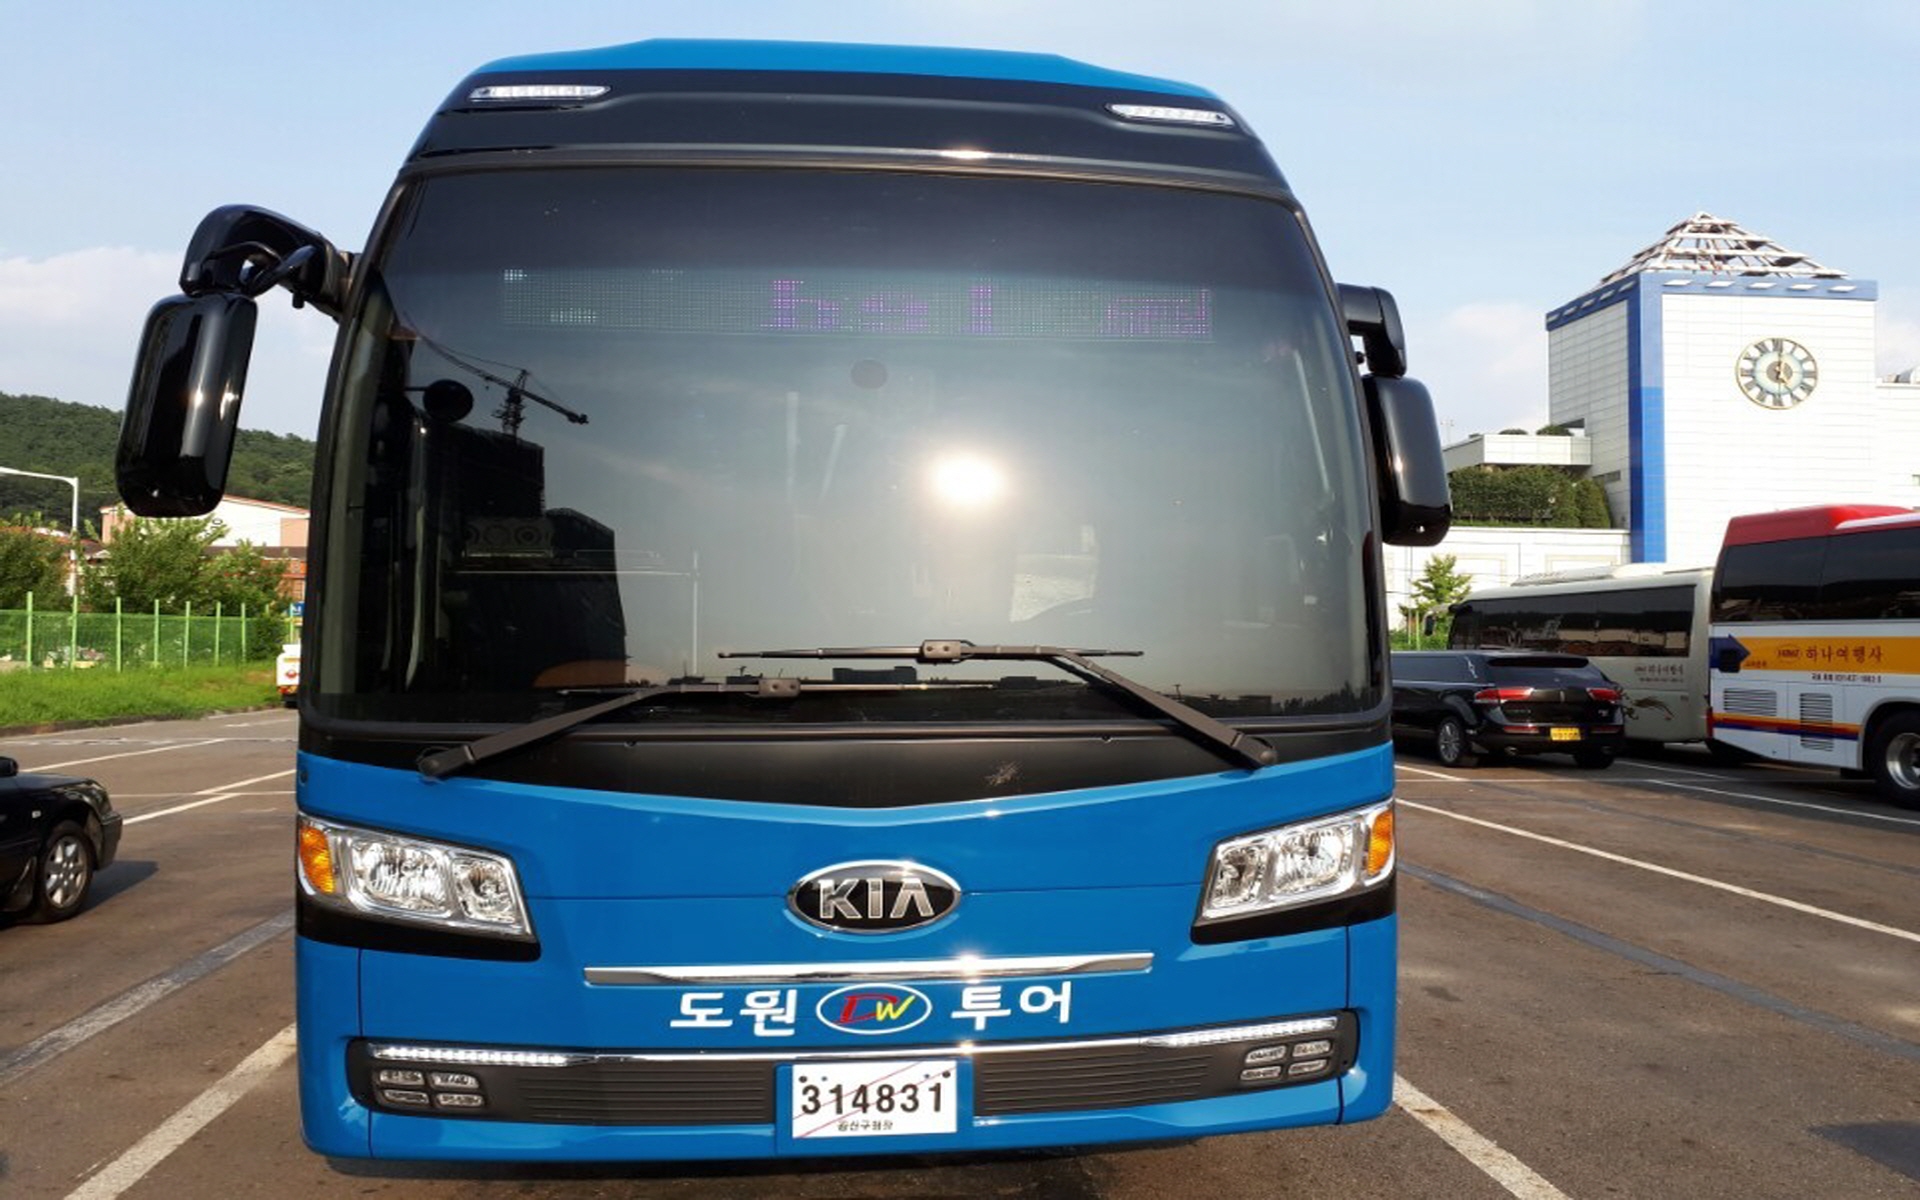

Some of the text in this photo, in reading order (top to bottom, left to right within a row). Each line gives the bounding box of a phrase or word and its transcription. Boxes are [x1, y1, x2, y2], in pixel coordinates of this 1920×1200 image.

[1806, 645, 1882, 664] 하나여행사
[817, 877, 936, 919] KIA
[669, 981, 1072, 1037] 도원 DW 투어
[802, 1082, 942, 1115] 314831
